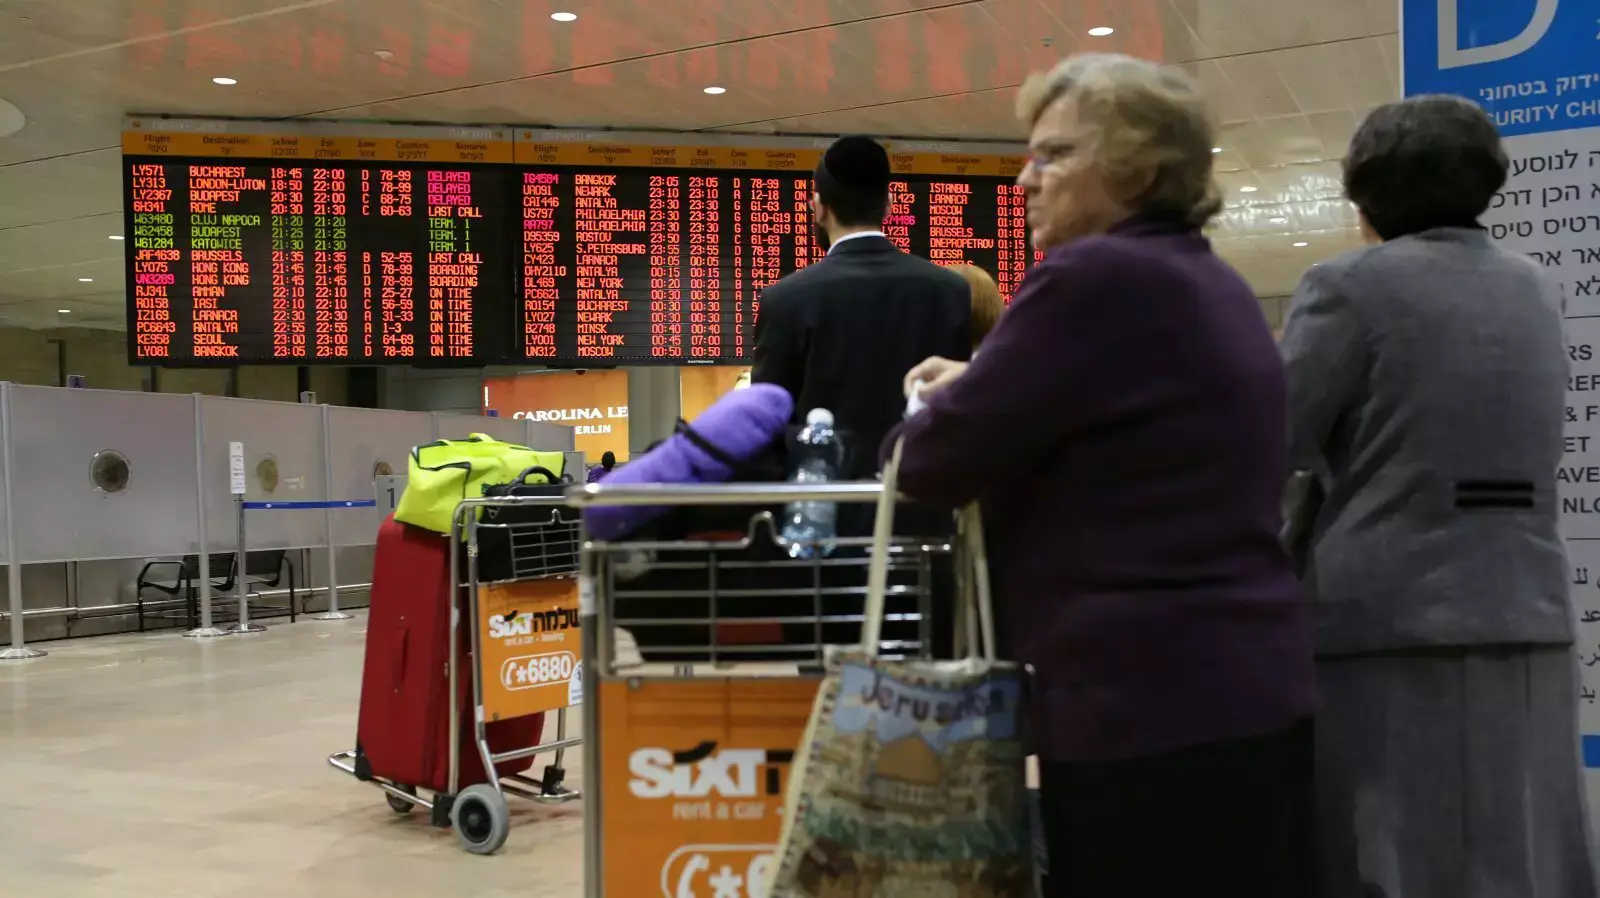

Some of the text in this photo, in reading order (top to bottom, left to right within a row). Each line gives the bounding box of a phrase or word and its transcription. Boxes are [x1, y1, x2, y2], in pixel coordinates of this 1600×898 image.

[1479, 73, 1600, 101] ידוק בטחוני
[1486, 103, 1559, 126] URITY
[202, 135, 249, 145] Destination
[1512, 149, 1579, 177] לנוסע
[133, 165, 470, 182] LY571 BUCHAREST 18:45 DELAYED
[133, 177, 265, 189] LY313 LONDON-LUTON
[575, 175, 616, 185] BANGKOK
[523, 185, 679, 198] UA091 NEWARK 23:10
[930, 183, 971, 194] ISTANBUL
[134, 189, 302, 202] LY2367 BUDAPEST 20:30
[892, 194, 967, 204] 1423 LARNACA
[1492, 189, 1532, 208] דרכ
[1542, 184, 1581, 208] הכן
[576, 198, 616, 208] ANTALYA
[190, 202, 216, 213] ROME
[314, 205, 345, 215] 21:30
[429, 206, 451, 217] LAST
[458, 206, 482, 218] CALL
[524, 208, 790, 222] US797 PHILADELPHIA G10-G19
[930, 205, 962, 215] MOSCOW
[192, 214, 216, 225] CLUJ
[223, 214, 260, 225] NAPOCA
[930, 216, 962, 226] MOSCOW
[524, 220, 645, 231] AA797 PHILADELPHIA
[1491, 215, 1600, 240] רטיס טיס
[135, 225, 303, 238] W62458 BUDAPEST 21:25
[576, 232, 611, 242] ROSTOV
[882, 226, 1024, 238] LY231 BRUSSELS 01:05
[135, 237, 241, 249] W61284 KATOWICE
[524, 243, 646, 254] LY625 S.PETERSBURG
[998, 240, 1024, 249] 01:15
[191, 250, 242, 261] BRUSSELS
[930, 249, 963, 259] ODESSA
[525, 254, 680, 266] CY423 LARNACA 00:05
[136, 261, 477, 275] LY075 HONG KONG BOARDING
[577, 266, 617, 277] ANTALYA
[192, 274, 218, 285] HONG
[223, 274, 249, 285] KONG
[273, 275, 304, 285] 21:45
[577, 278, 595, 288] NEW
[600, 278, 623, 288] YORK
[136, 286, 472, 298] RJ341 AMMAN ON TIME
[525, 289, 618, 299] PC6621 ANTALYA
[194, 298, 217, 309] IASI
[382, 299, 413, 310] 56-59
[577, 301, 628, 311] BUCHAREST
[193, 310, 237, 321] LARNACA
[316, 311, 347, 321] 22:30
[525, 312, 612, 322] LY027 NEWARK
[137, 322, 305, 333] PC6643 ANTALYA 22:55
[526, 323, 607, 334] B2748 MINSK
[137, 334, 225, 345] KE958 SEOUL
[526, 335, 720, 345] LY001 NEW YORK 07:00
[138, 346, 238, 357] LY081 BANGKOK
[526, 346, 681, 357] UN312 MOSCOW 00:50
[513, 407, 603, 421] CAROLINA
[575, 424, 611, 434] ERLIN
[386, 487, 395, 508] 1
